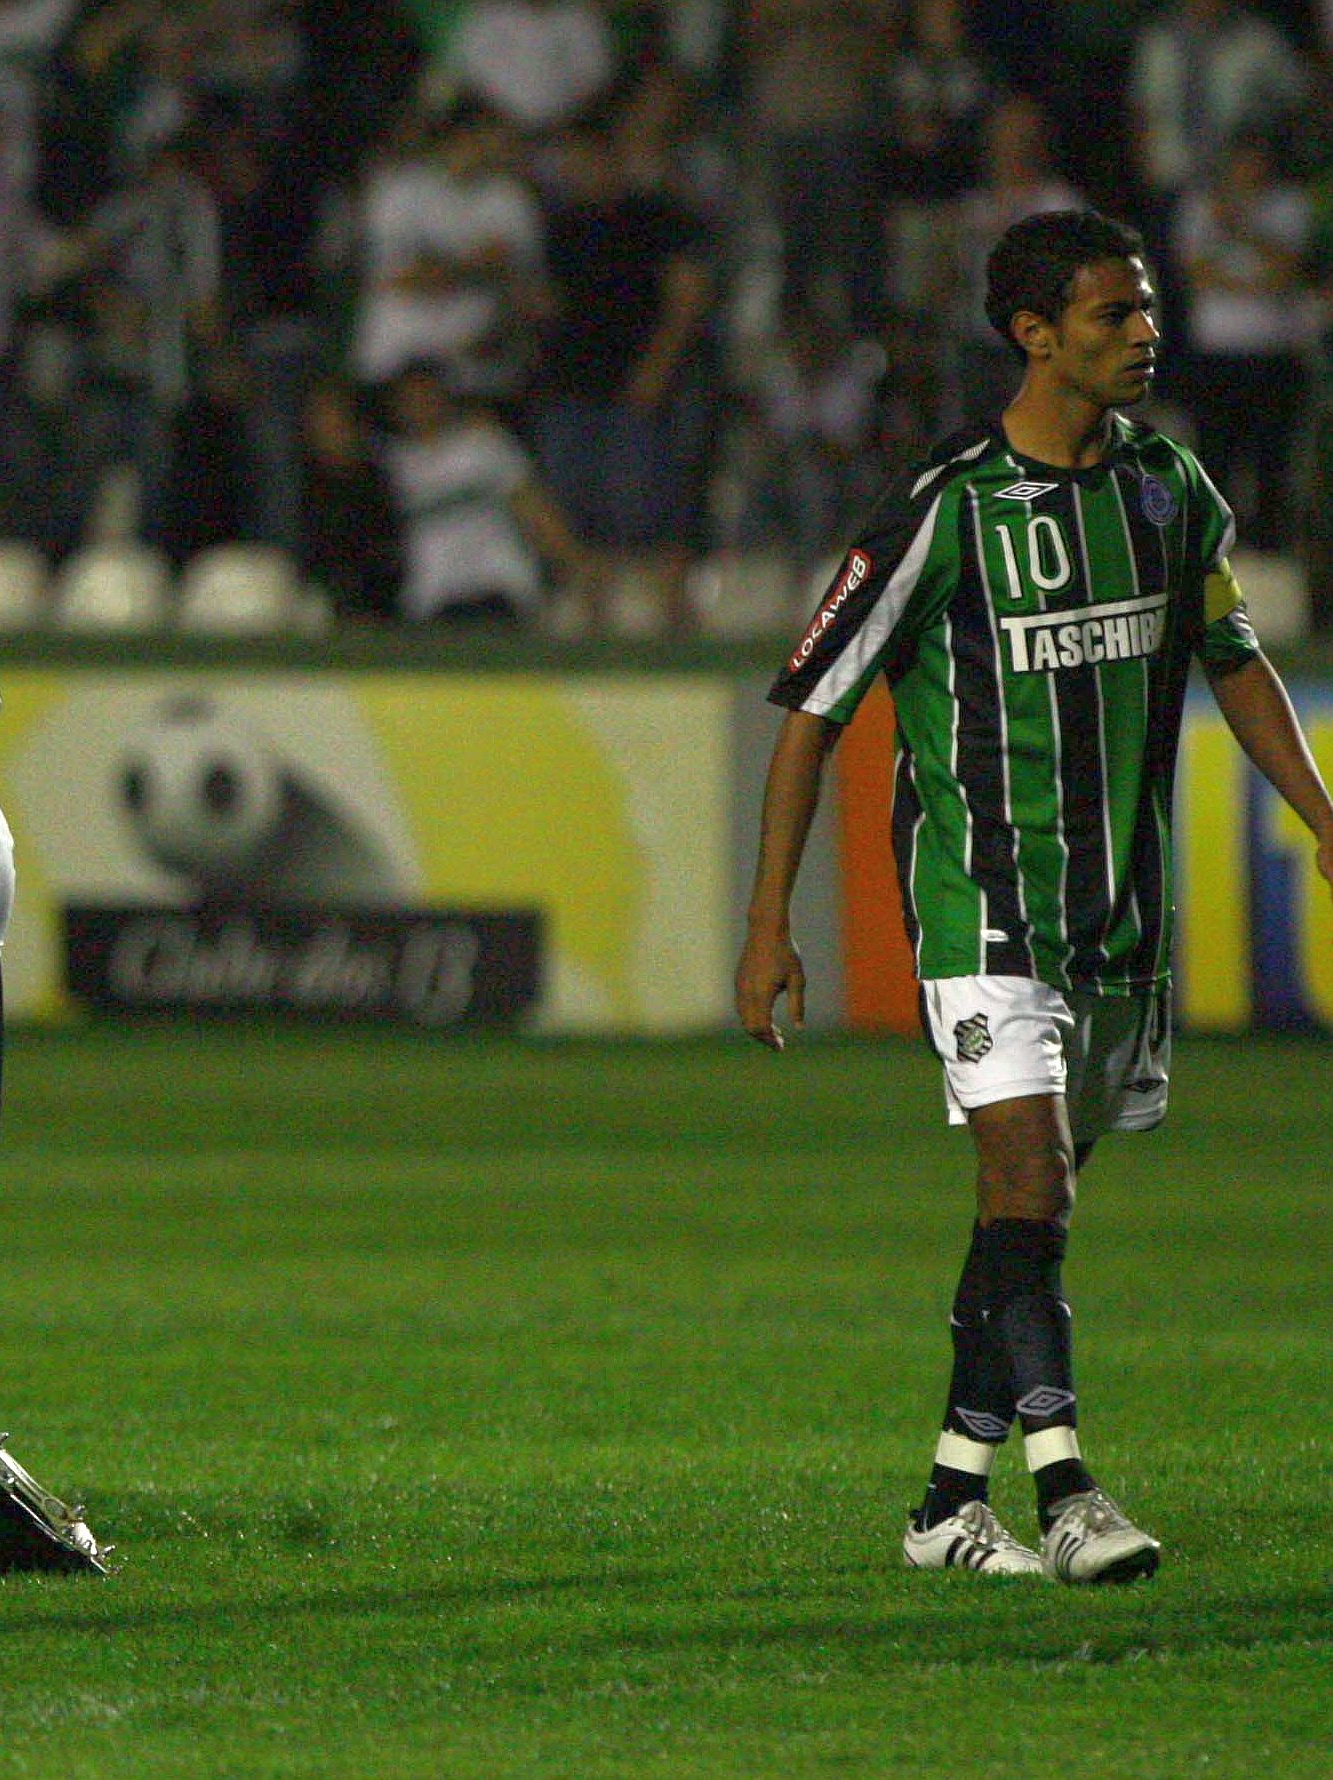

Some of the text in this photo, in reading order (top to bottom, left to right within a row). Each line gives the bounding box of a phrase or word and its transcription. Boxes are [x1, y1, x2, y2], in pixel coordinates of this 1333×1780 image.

[994, 515, 1071, 599] 10
[793, 554, 866, 668] LOCAWEB
[1000, 593, 1167, 672] TASCHIB
